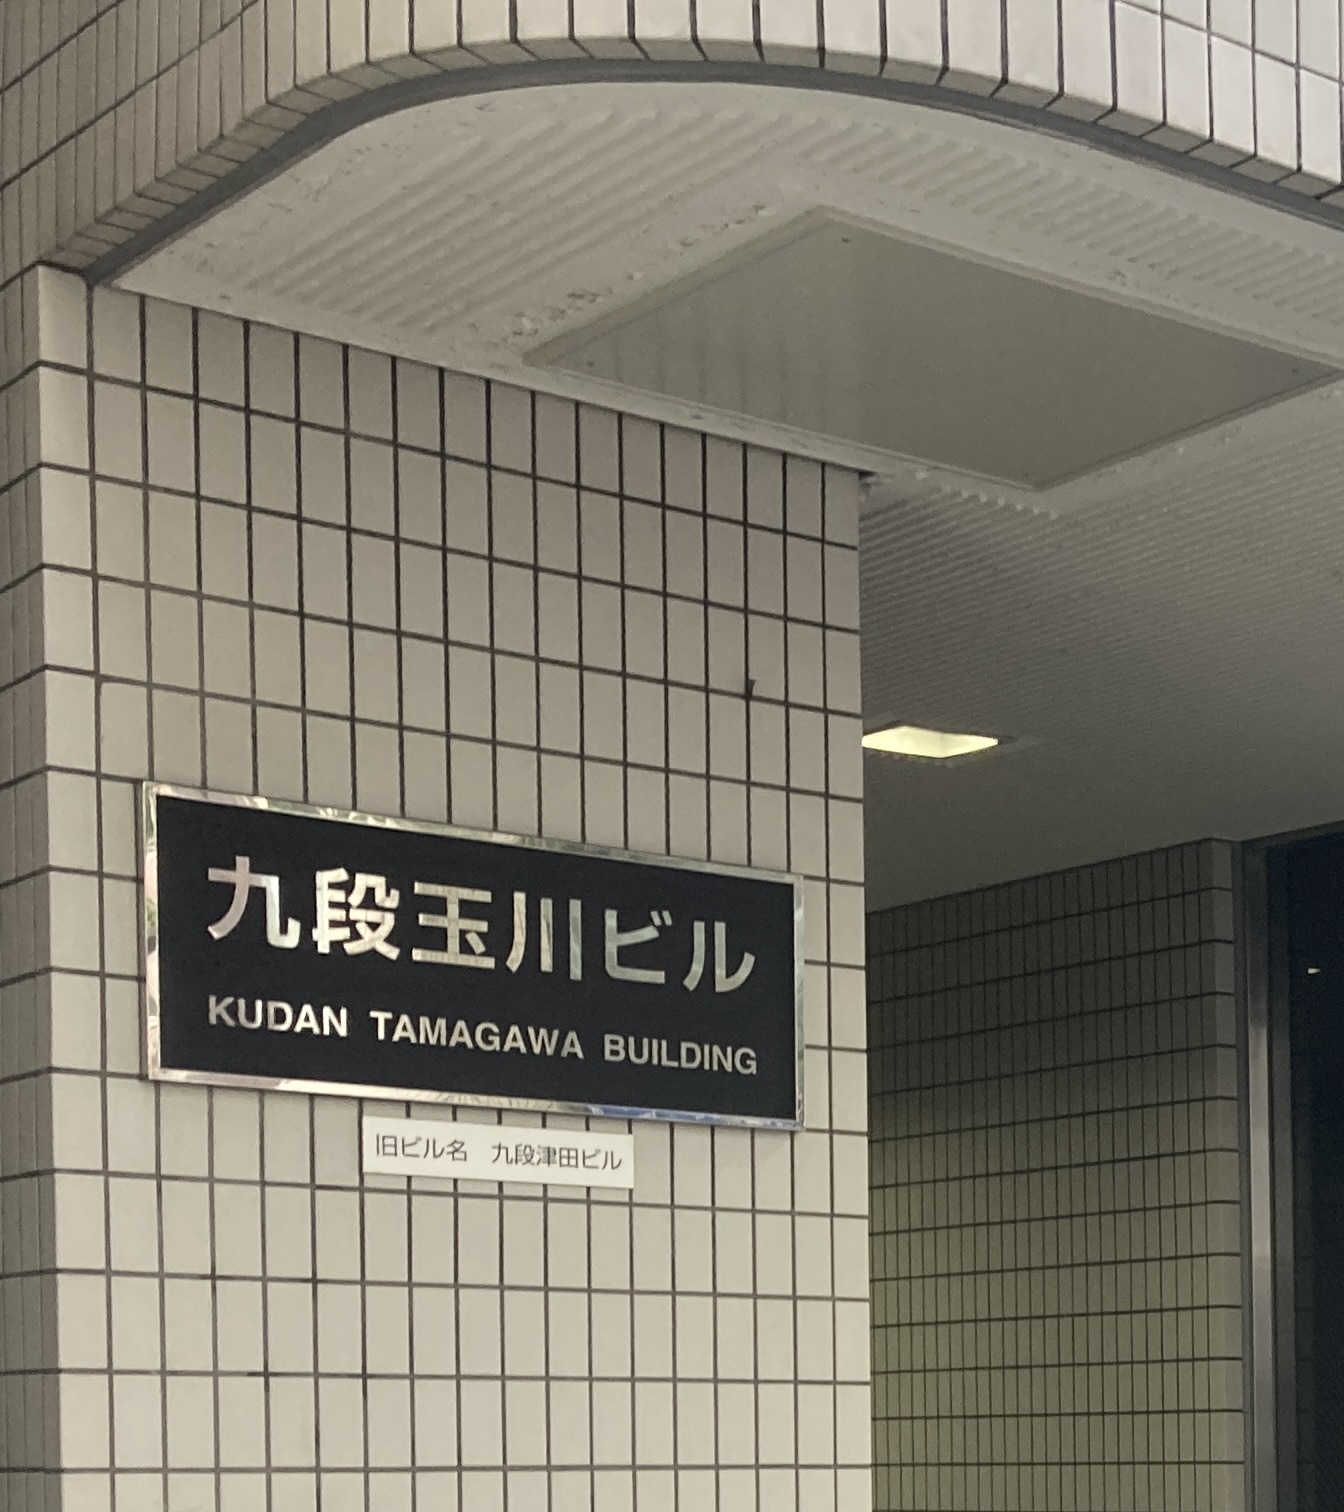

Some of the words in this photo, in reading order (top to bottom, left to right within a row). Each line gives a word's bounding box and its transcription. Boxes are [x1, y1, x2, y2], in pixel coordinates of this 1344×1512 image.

[207, 855, 755, 993] 九段玉川ビル
[208, 996, 348, 1038] KUDAN
[370, 1011, 584, 1060] TAMAGAWA
[604, 1034, 758, 1075] BUILDING
[376, 1133, 468, 1162] 旧ビル名
[491, 1142, 622, 1171] 九段津田ビル
